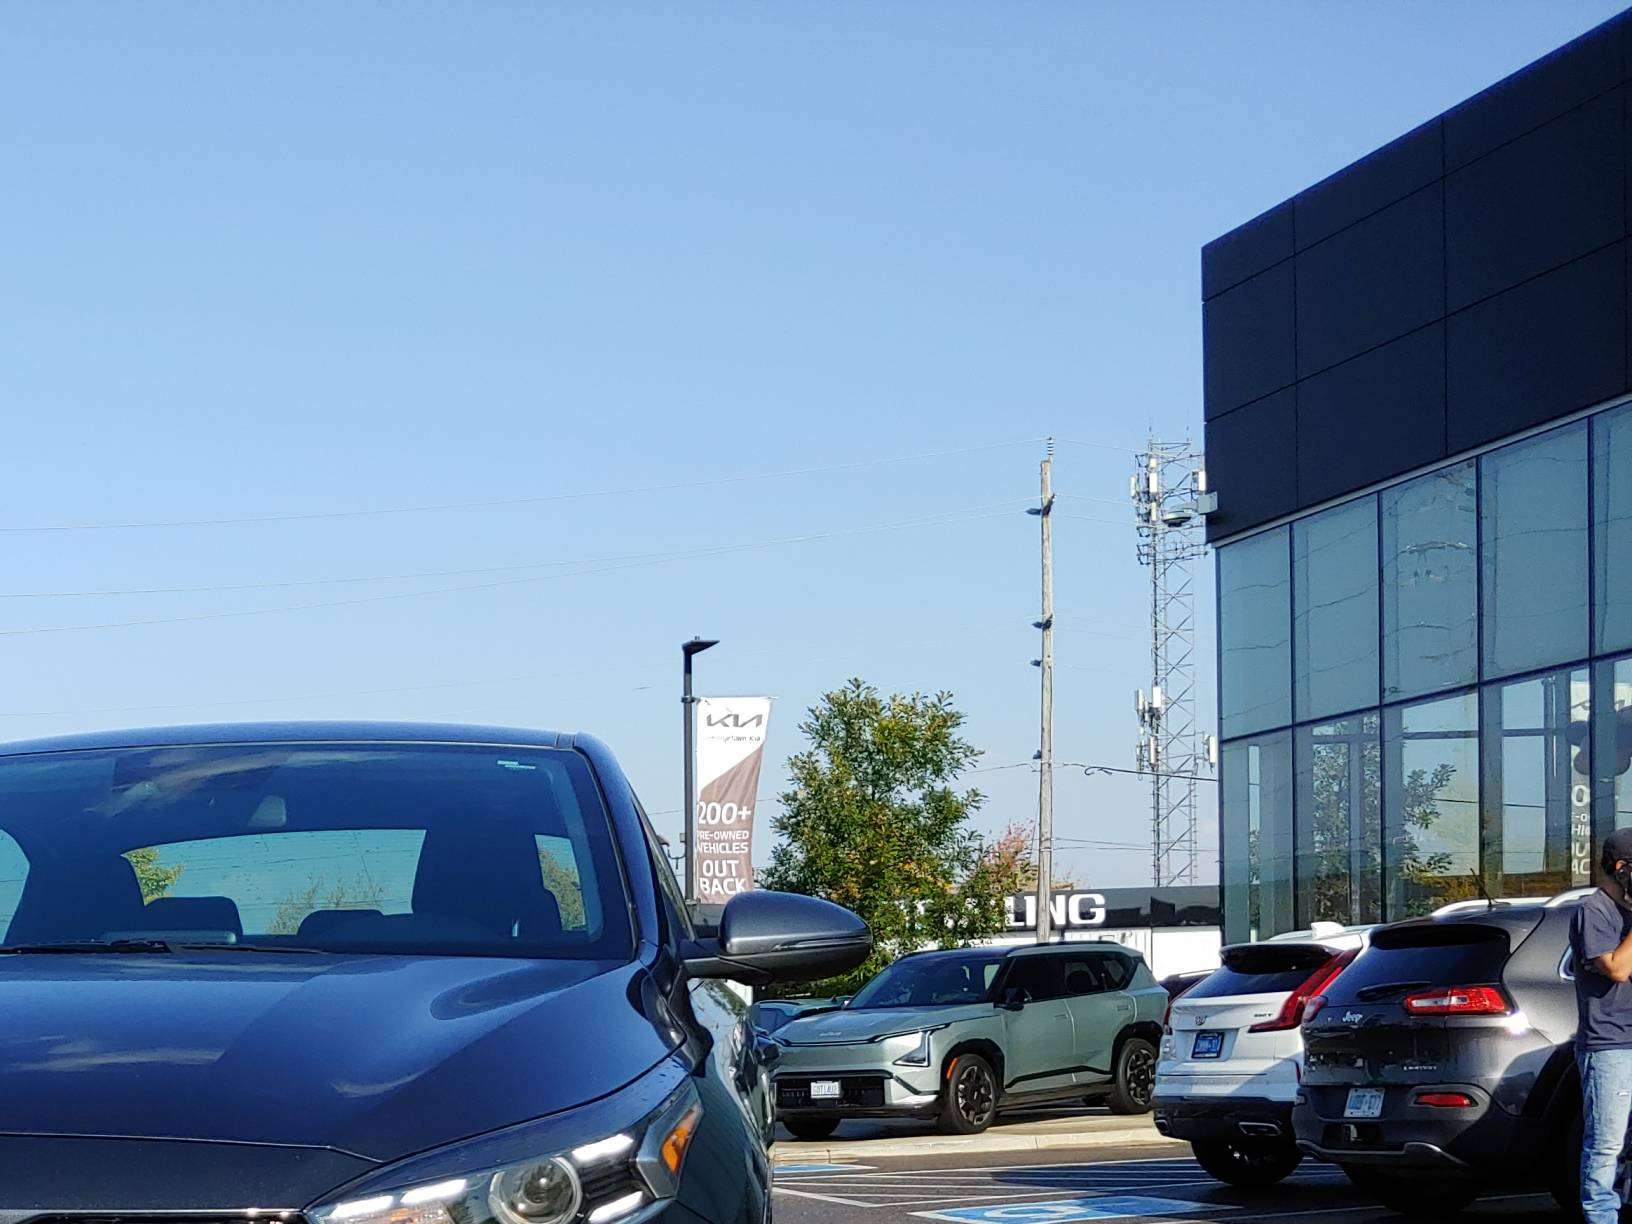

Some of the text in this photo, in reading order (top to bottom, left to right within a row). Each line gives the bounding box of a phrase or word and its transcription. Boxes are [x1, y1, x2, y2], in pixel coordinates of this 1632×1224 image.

[697, 801, 752, 825] 200+
[696, 841, 749, 854] VEHICLES
[702, 859, 739, 877] OUT
[699, 877, 746, 896] BACK
